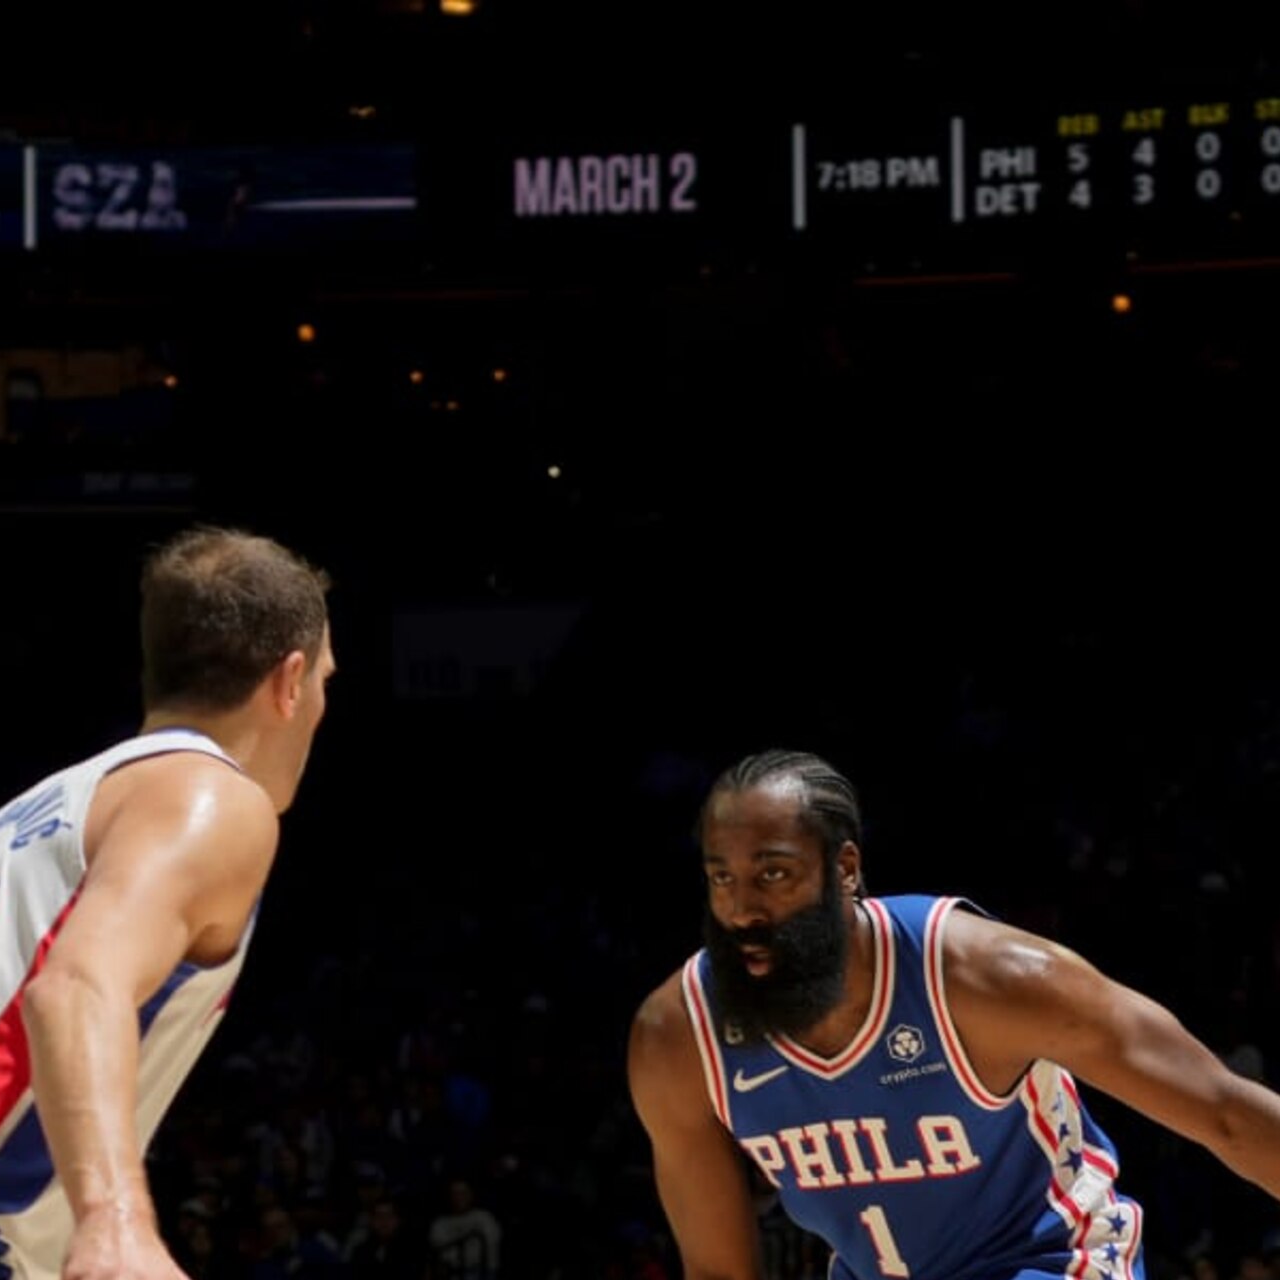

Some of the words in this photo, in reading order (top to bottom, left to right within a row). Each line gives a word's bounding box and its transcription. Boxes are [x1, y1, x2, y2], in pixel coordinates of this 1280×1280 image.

[1122, 107, 1166, 131] AST
[513, 153, 661, 217] MARCH
[669, 151, 698, 212] 2
[817, 158, 881, 191] 7:18
[885, 155, 941, 189] PM
[978, 146, 1038, 180] PHI
[1067, 142, 1091, 173] 5
[1131, 137, 1157, 168] 4
[1194, 131, 1222, 162] 0
[51, 161, 188, 231] SZA
[974, 181, 1042, 217] DET
[1067, 178, 1092, 209] 4
[1131, 172, 1156, 205] 3
[1195, 167, 1222, 199] 0
[738, 1113, 983, 1192] PHILA
[858, 1203, 912, 1280] 1
